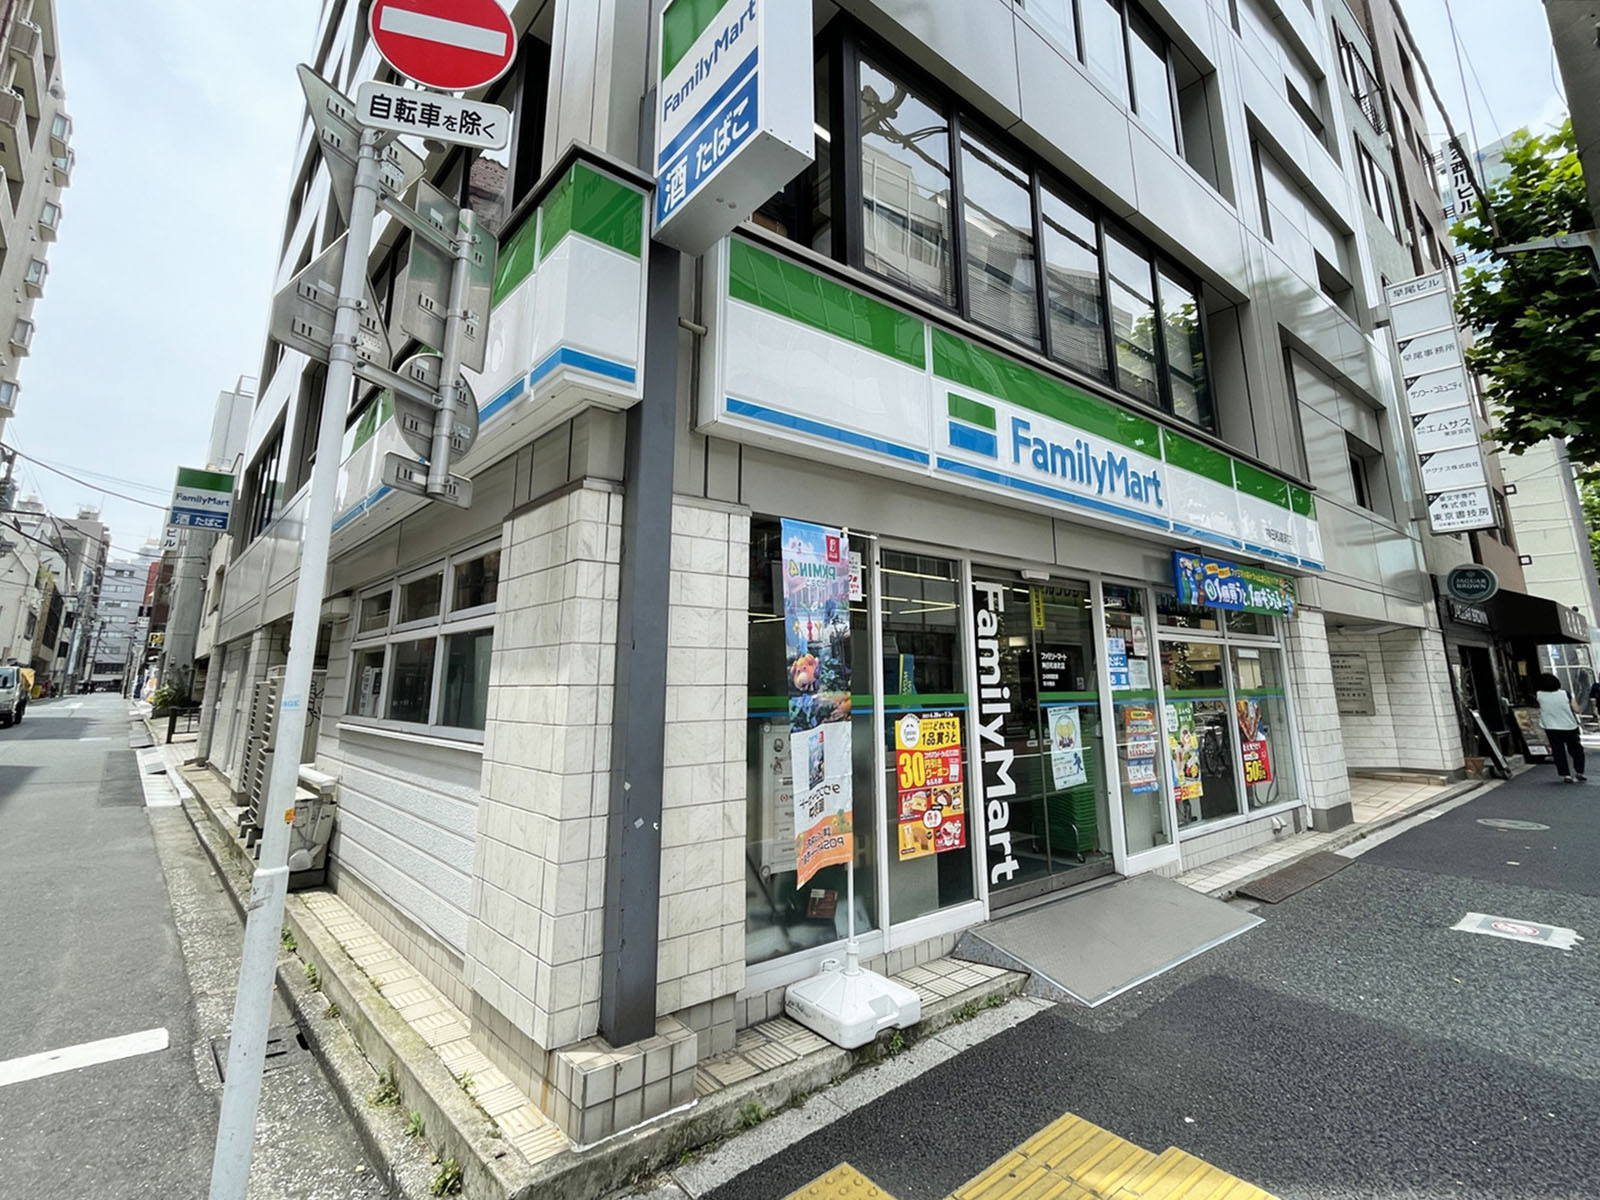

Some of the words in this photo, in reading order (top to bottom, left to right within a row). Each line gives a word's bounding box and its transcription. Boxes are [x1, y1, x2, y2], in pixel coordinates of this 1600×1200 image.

[663, 0, 757, 122] FamilyMart
[369, 93, 496, 140] 自転車を除く
[664, 155, 689, 214] 酒
[695, 96, 750, 180] たばこ
[1011, 416, 1164, 506] FamilyMart
[176, 492, 230, 508] FamilyMart
[194, 516, 223, 528] たばこ
[922, 732, 957, 746] 1品買うと
[933, 720, 957, 731] どれでも
[974, 580, 1021, 885] FamilyMart
[899, 751, 926, 789] 30
